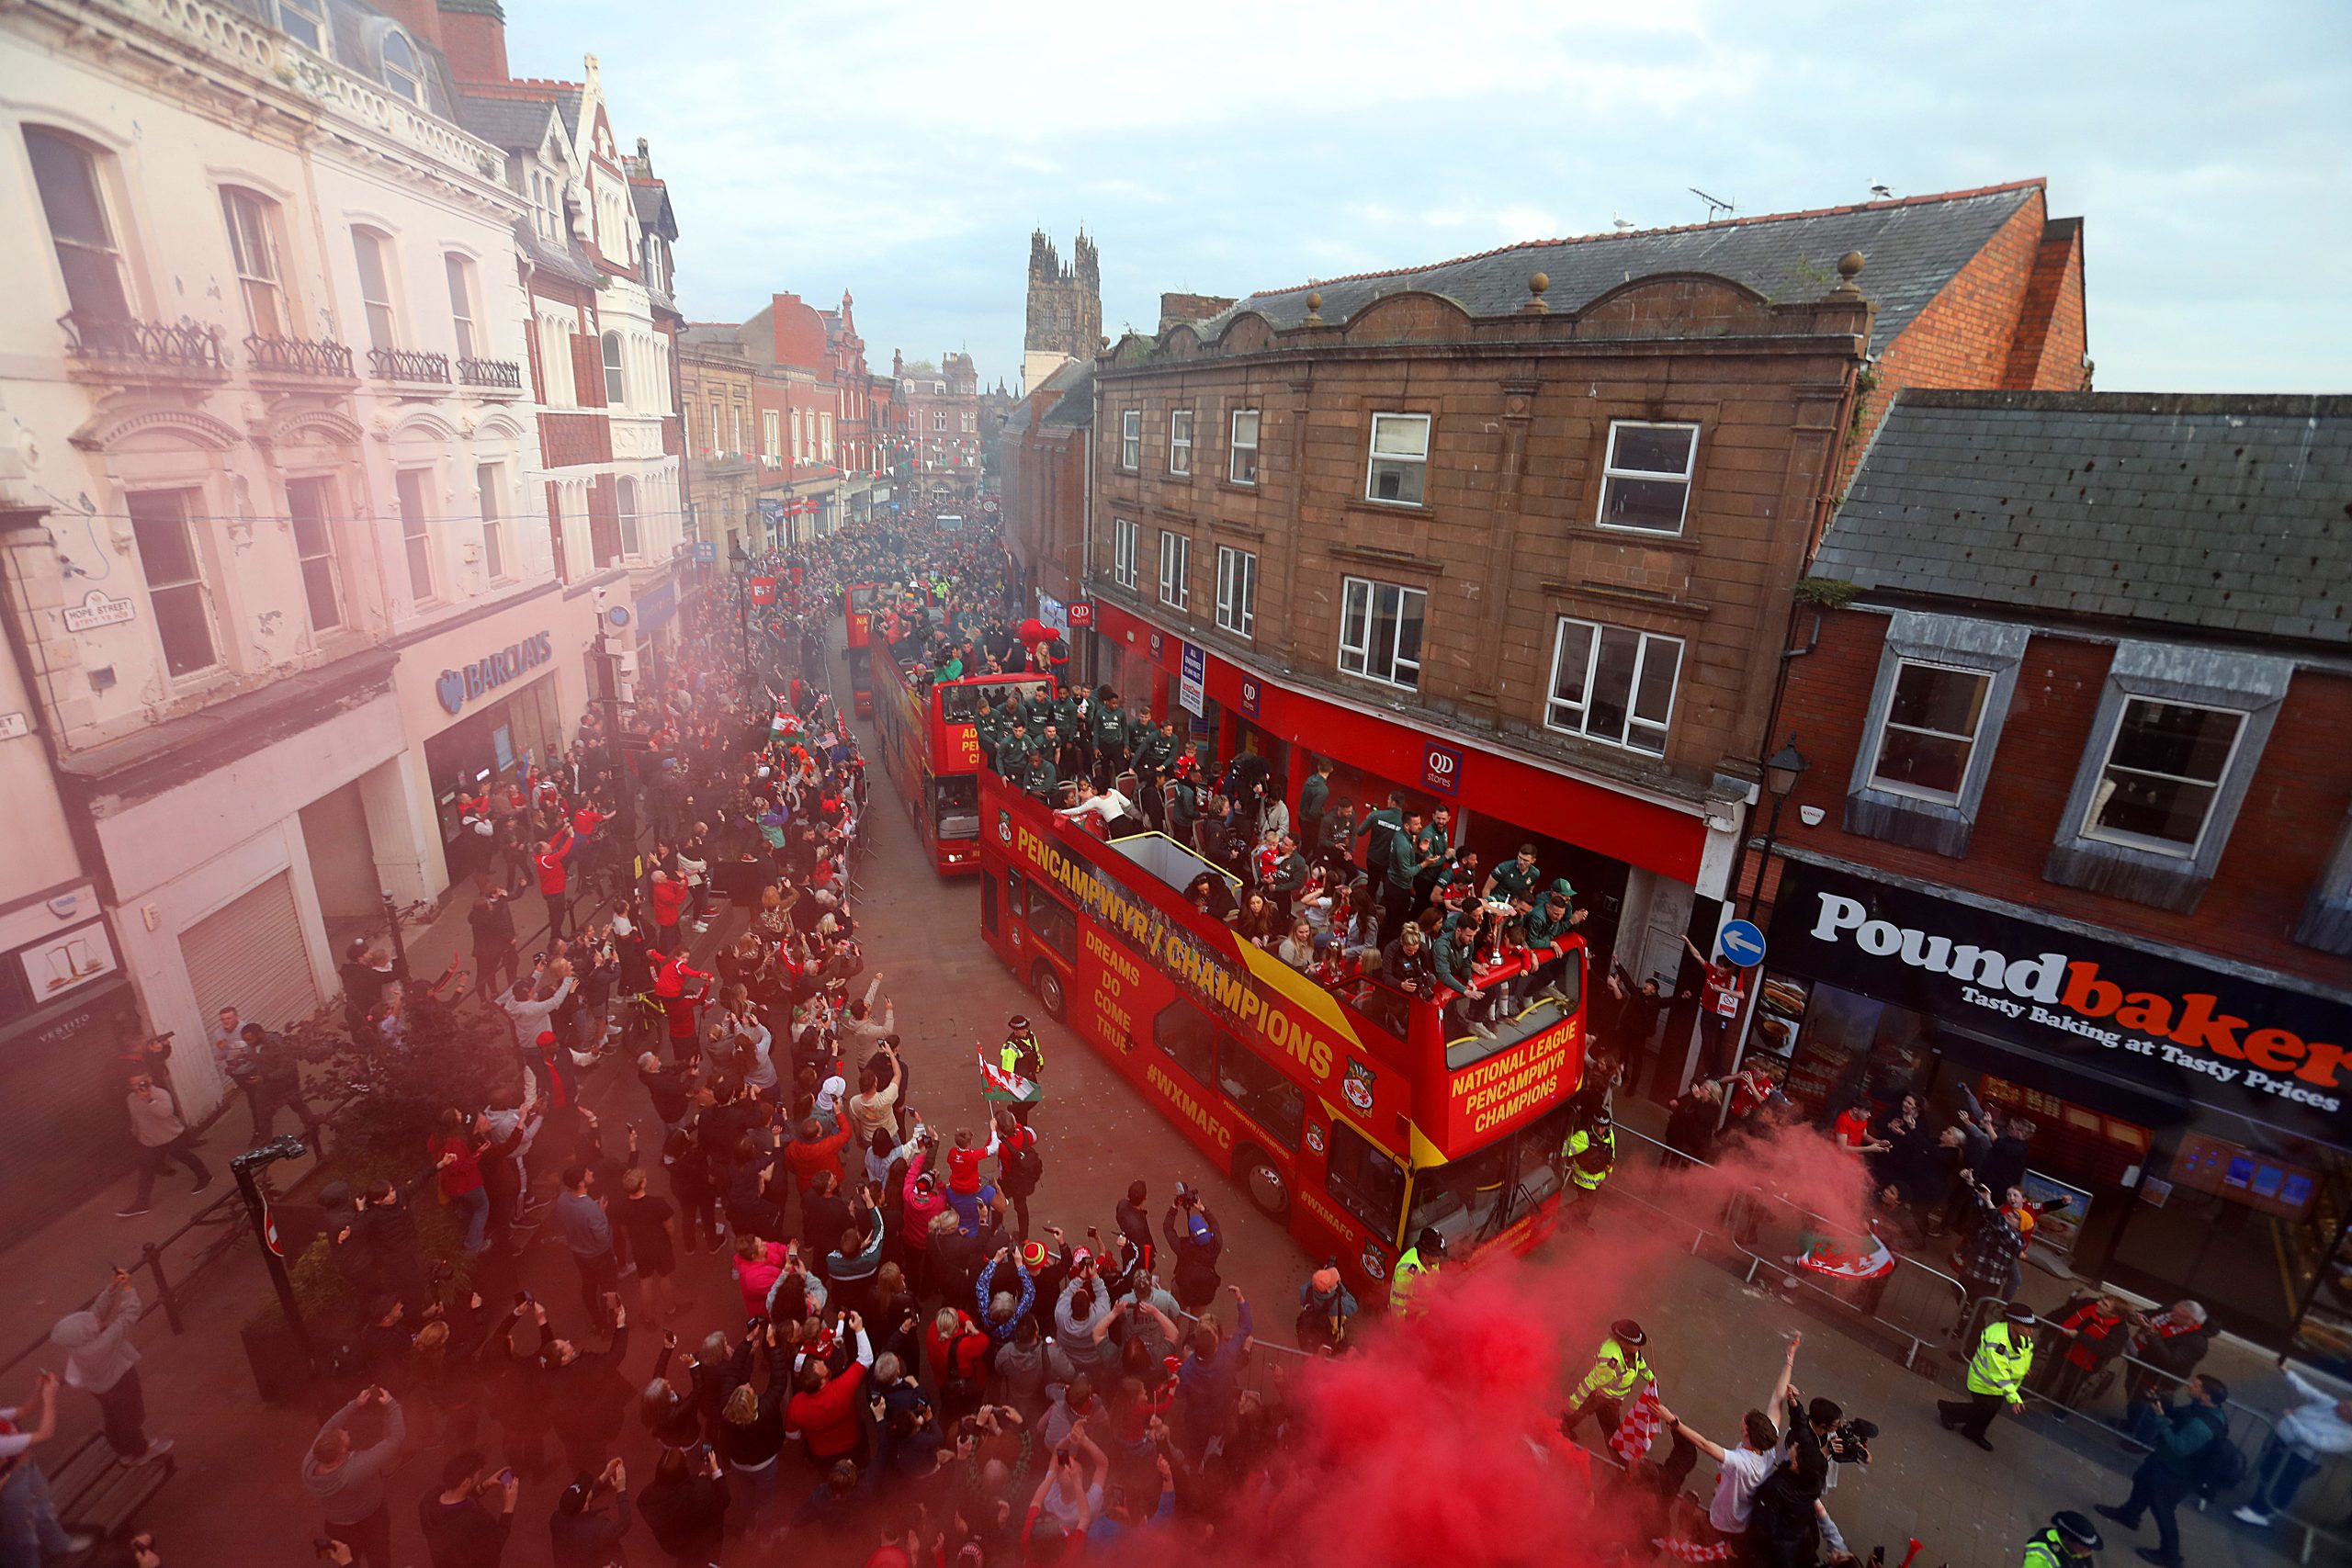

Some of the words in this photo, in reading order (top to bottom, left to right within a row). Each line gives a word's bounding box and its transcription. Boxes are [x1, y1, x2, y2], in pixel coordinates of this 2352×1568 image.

[69, 608, 93, 620] HOPE
[96, 602, 128, 615] STREET
[1071, 605, 1089, 617] QD
[1150, 633, 1159, 649] QD
[463, 630, 552, 702] BARCLAYS
[1244, 682, 1255, 700] QD
[1427, 772, 1451, 787] stores
[1429, 751, 1453, 774] QD
[1018, 826, 1148, 945] PENCAMPWYR
[1166, 936, 1333, 1079] CHAMPIONS
[1085, 930, 1140, 987] DREAMS
[1102, 969, 1121, 998] DO
[39, 1013, 90, 1043] VESTITO
[1094, 988, 1131, 1032] COME
[1096, 1014, 1127, 1055] TRUE
[1961, 986, 2027, 1019] Tasty
[2029, 1005, 2122, 1048] Baking
[2124, 1038, 2156, 1055] at
[2161, 1044, 2240, 1082] Tasty
[2243, 1069, 2340, 1112] Prices
[1452, 1050, 1526, 1098] NATIONAL
[1529, 1021, 1577, 1064] LEAGUE
[1465, 1049, 1566, 1115] PENCAMPWYR
[1475, 1075, 1557, 1133] CHAMPIONS
[1147, 1063, 1231, 1150] #WXMAFC
[1301, 1190, 1353, 1241] #WXMAFC
